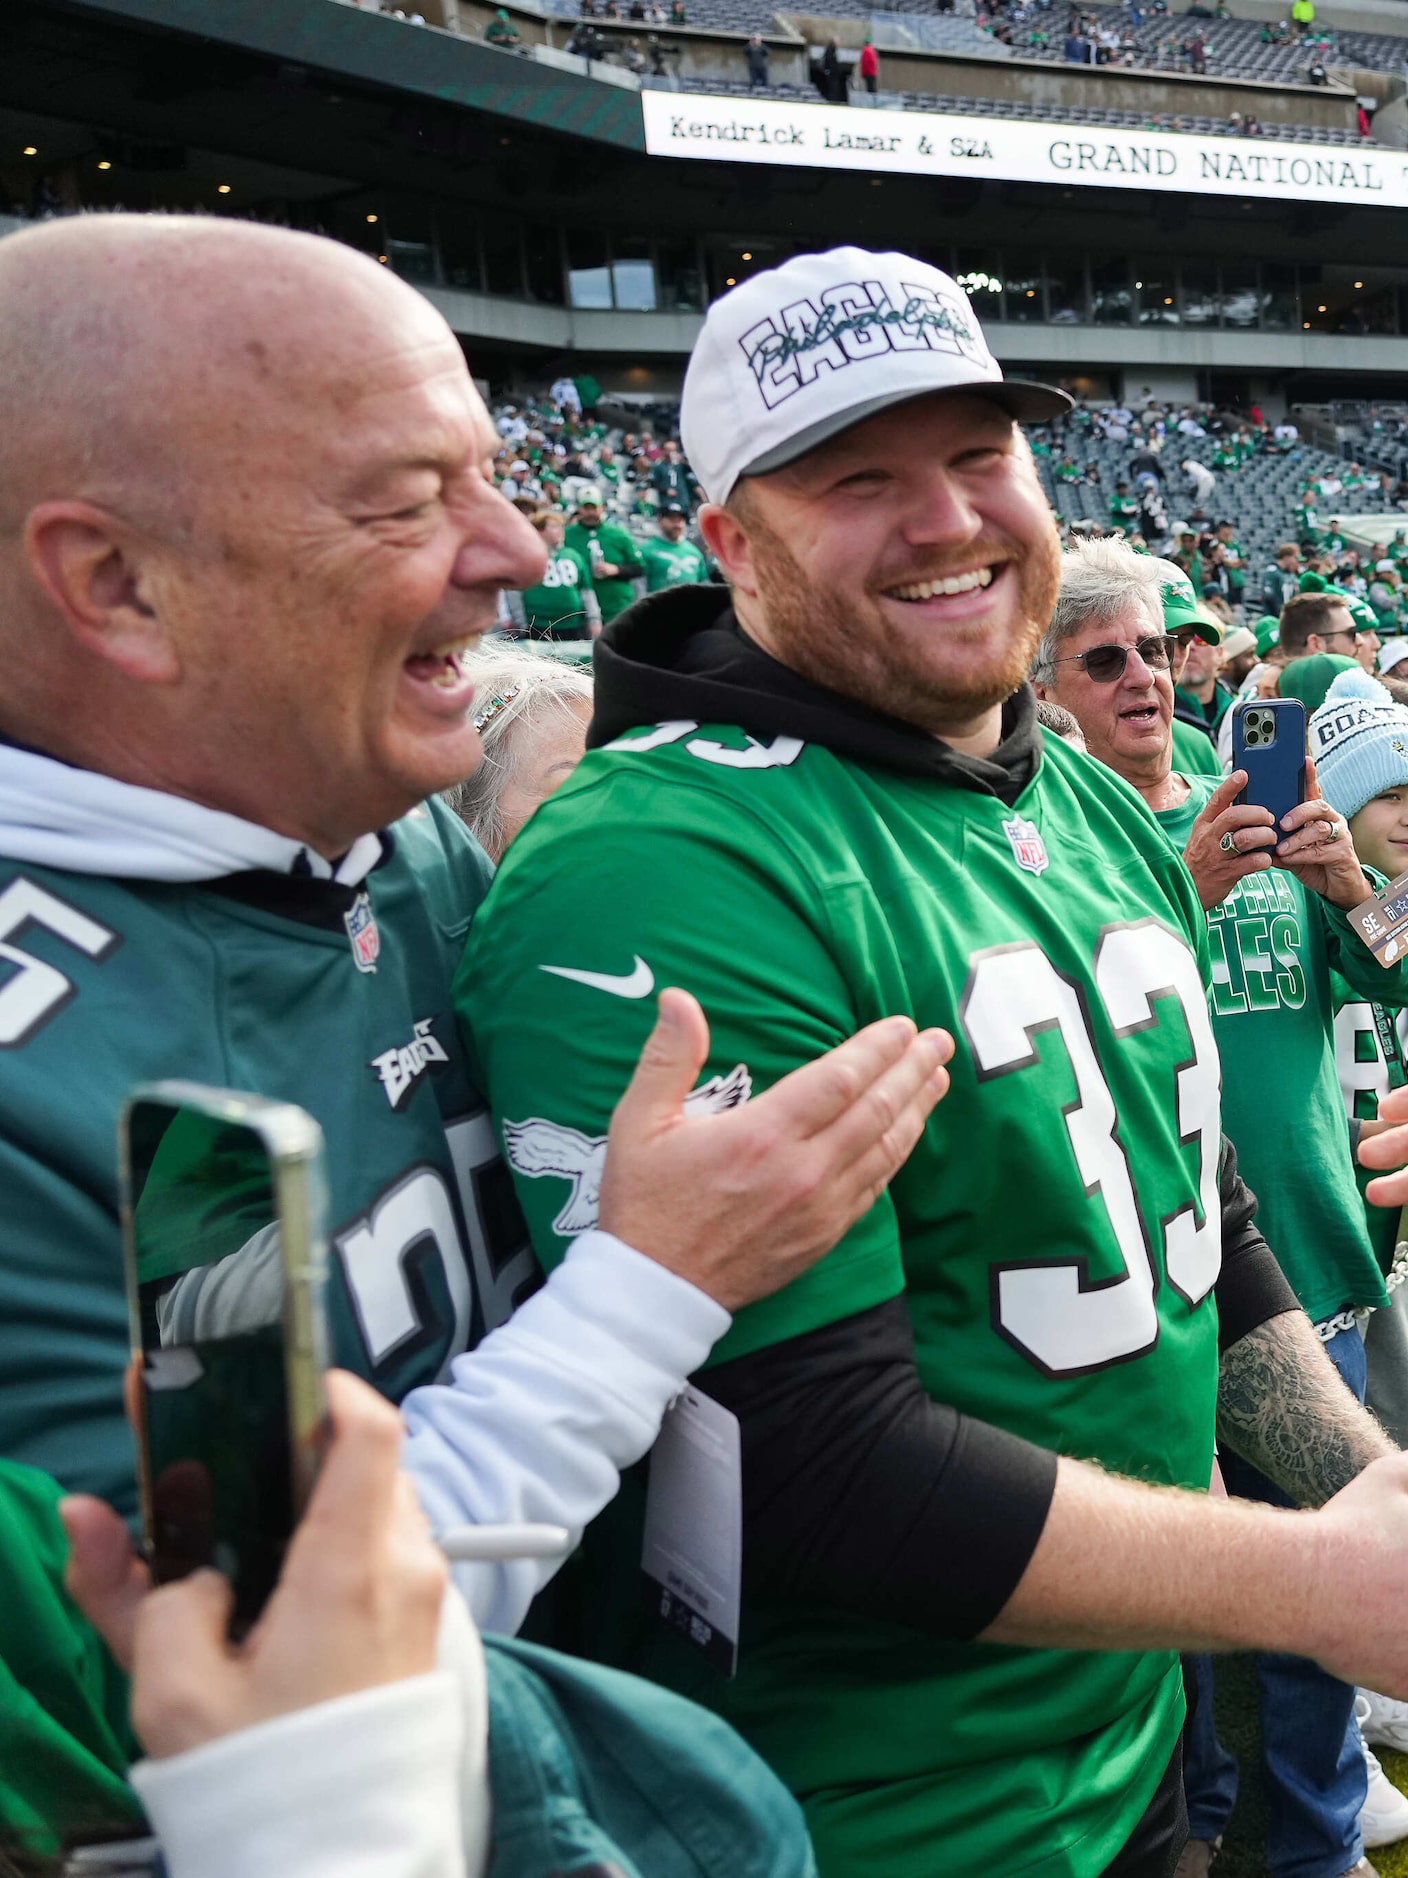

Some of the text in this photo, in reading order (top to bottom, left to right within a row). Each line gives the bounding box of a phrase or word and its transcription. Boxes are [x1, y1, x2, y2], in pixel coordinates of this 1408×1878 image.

[671, 115, 805, 146] Kendrick
[824, 127, 902, 153] Lamar
[918, 135, 933, 155] &
[1048, 140, 1178, 177] GRAND
[1200, 151, 1383, 191] NATIONAL
[738, 281, 988, 411] EAGLES
[1361, 911, 1380, 935] SE
[957, 917, 1223, 1379] 33
